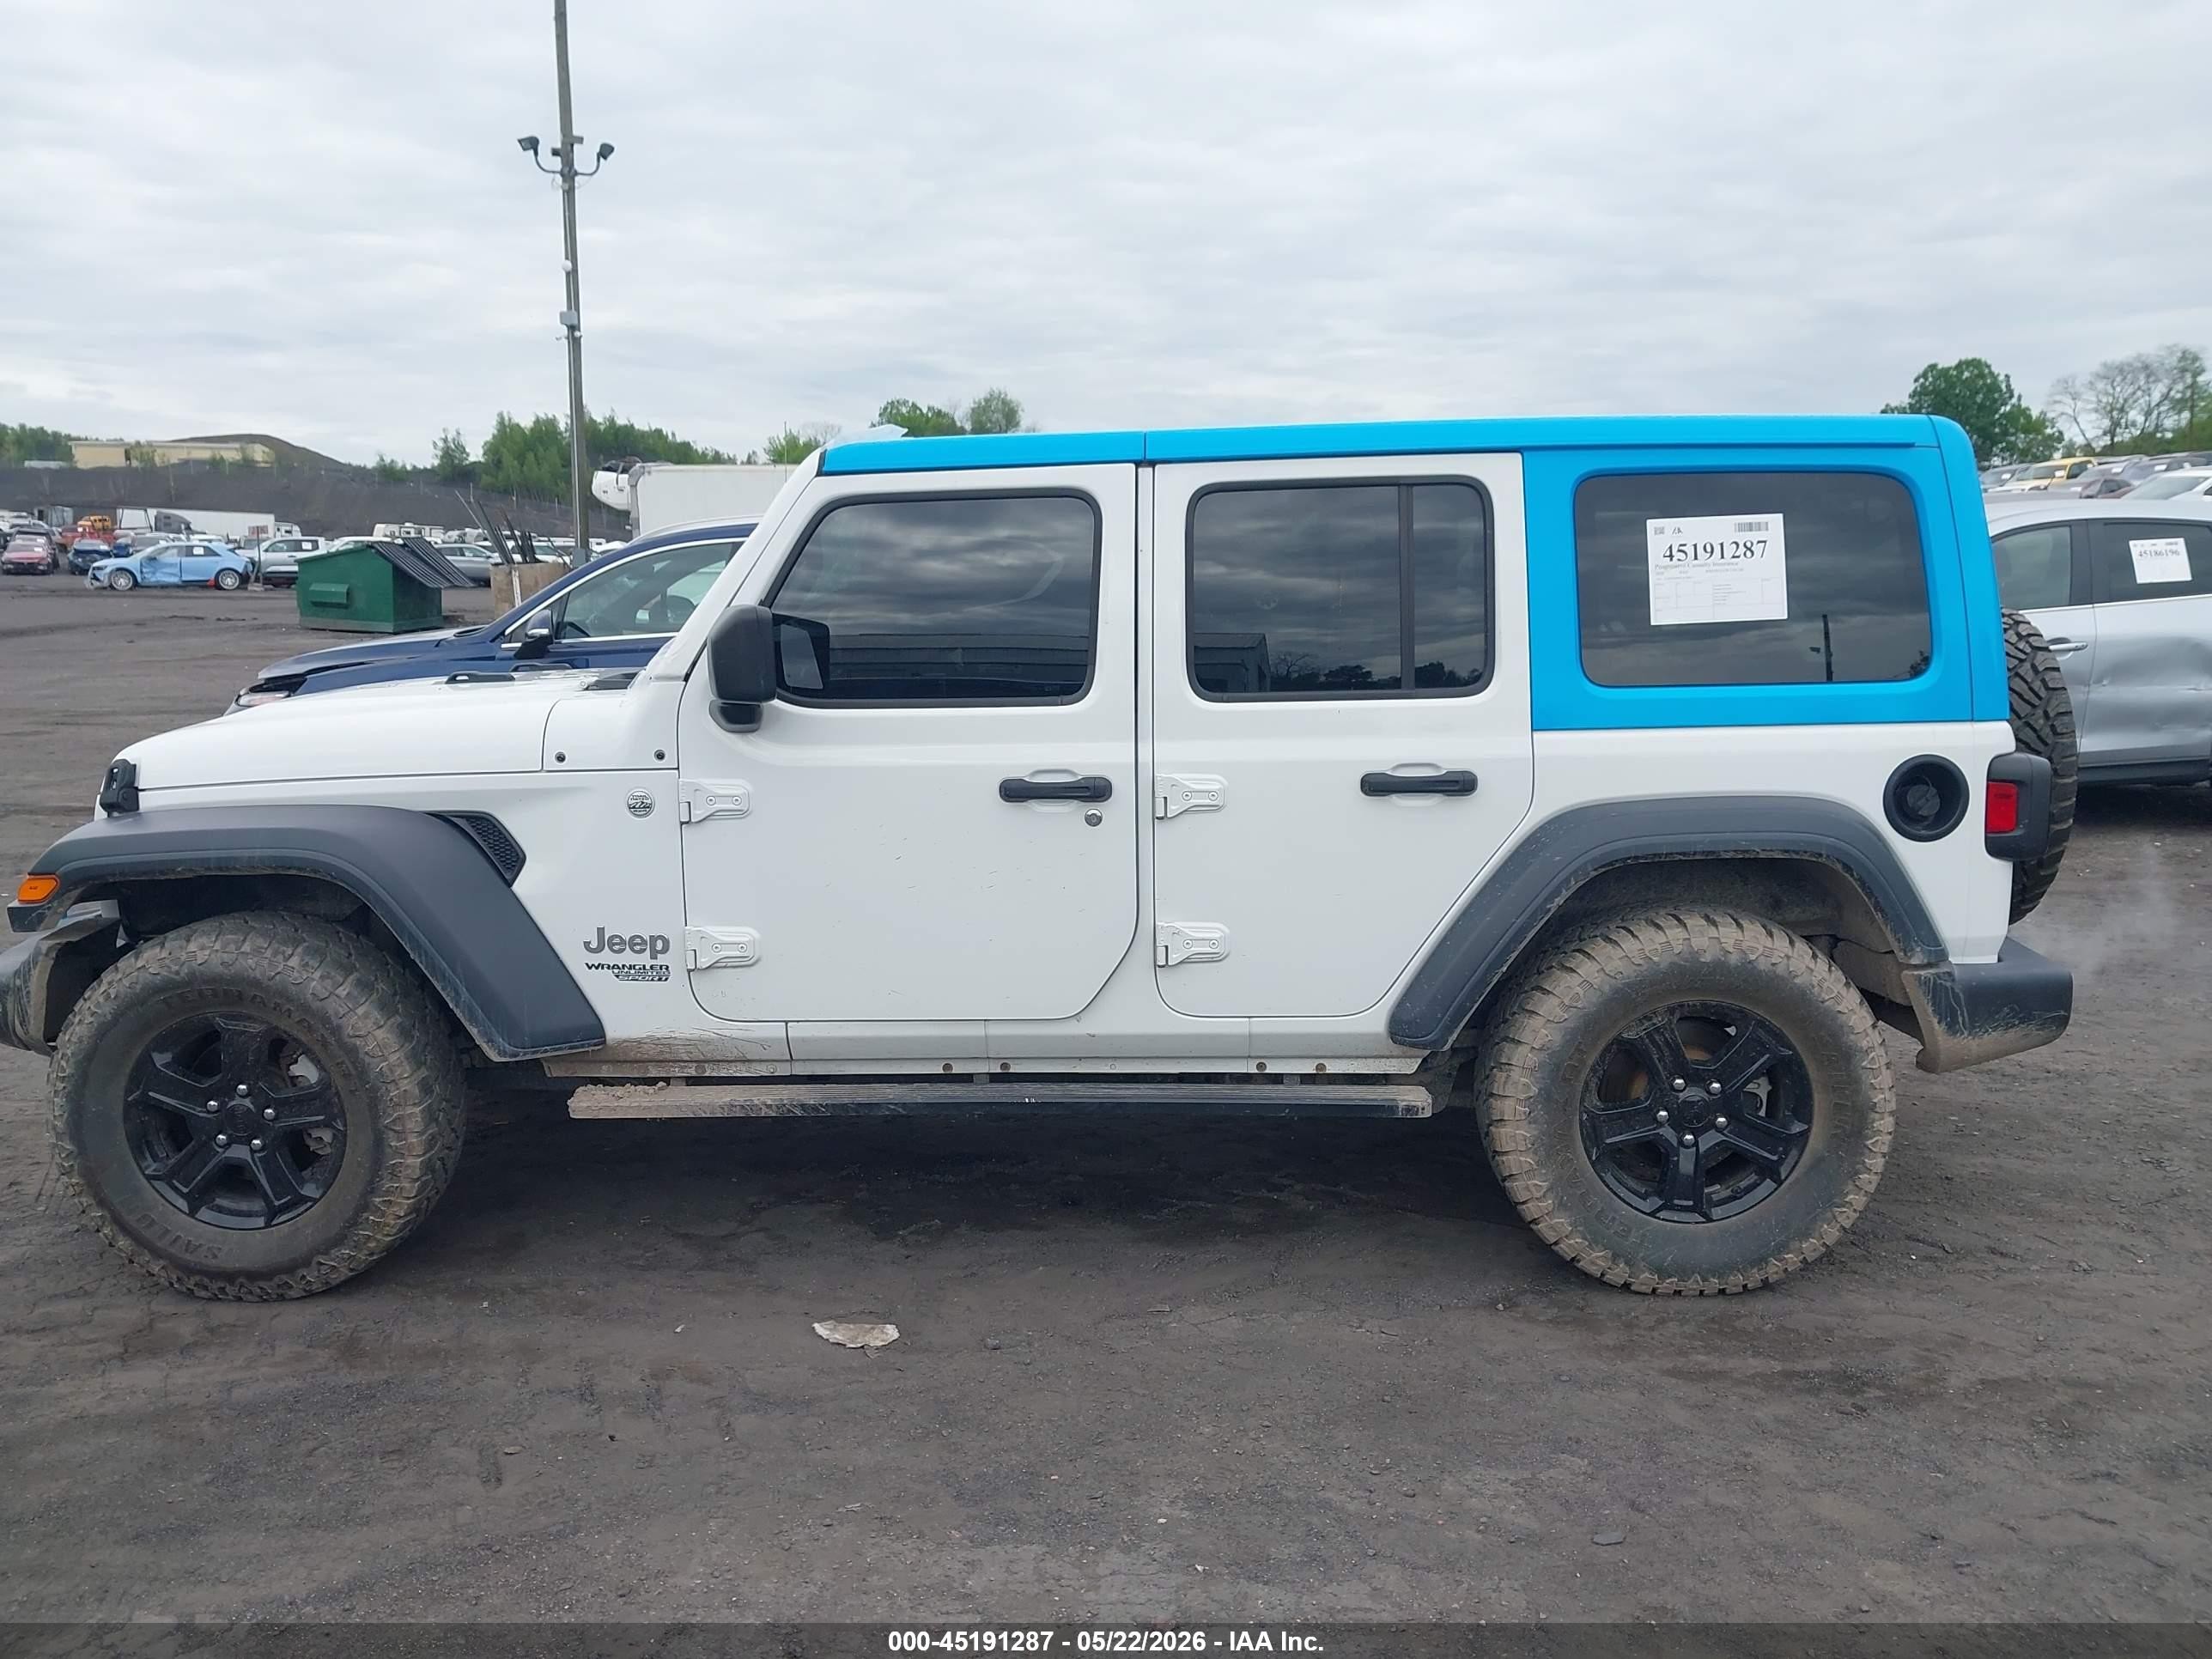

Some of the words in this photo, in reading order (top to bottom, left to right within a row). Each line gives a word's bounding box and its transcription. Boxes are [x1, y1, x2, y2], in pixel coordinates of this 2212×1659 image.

[1662, 540, 1767, 562] 45191287
[583, 927, 671, 960] Jeep
[585, 962, 670, 971] WRANGLER
